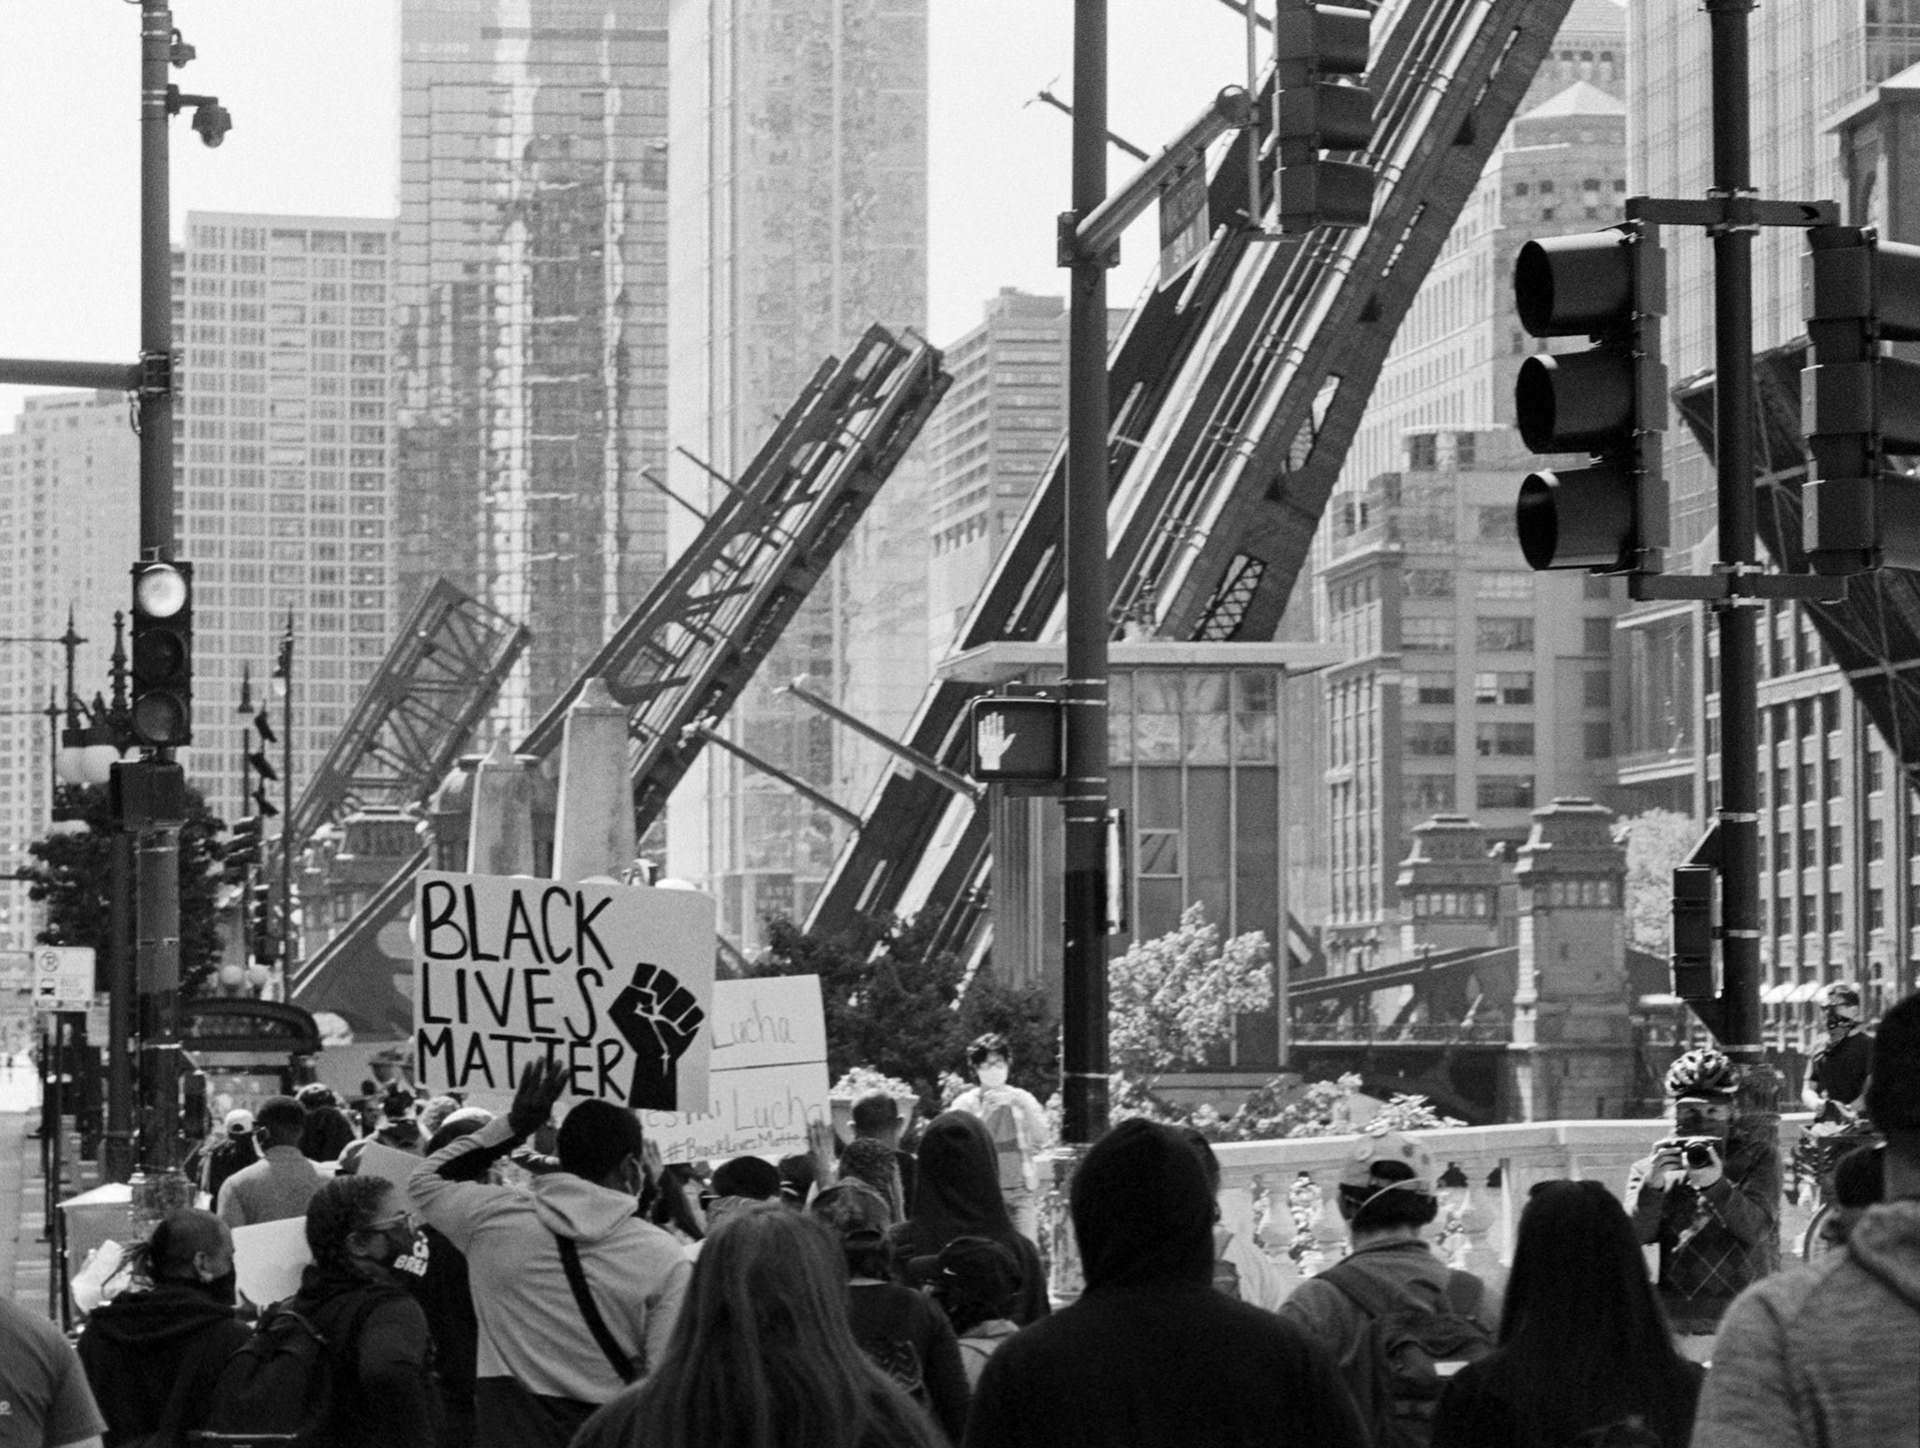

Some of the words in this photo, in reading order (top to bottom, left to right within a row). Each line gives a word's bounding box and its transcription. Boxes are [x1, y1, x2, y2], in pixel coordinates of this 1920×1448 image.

[421, 880, 614, 971] BLACK
[421, 962, 604, 1042] LIVES
[418, 1026, 627, 1100] MATTER
